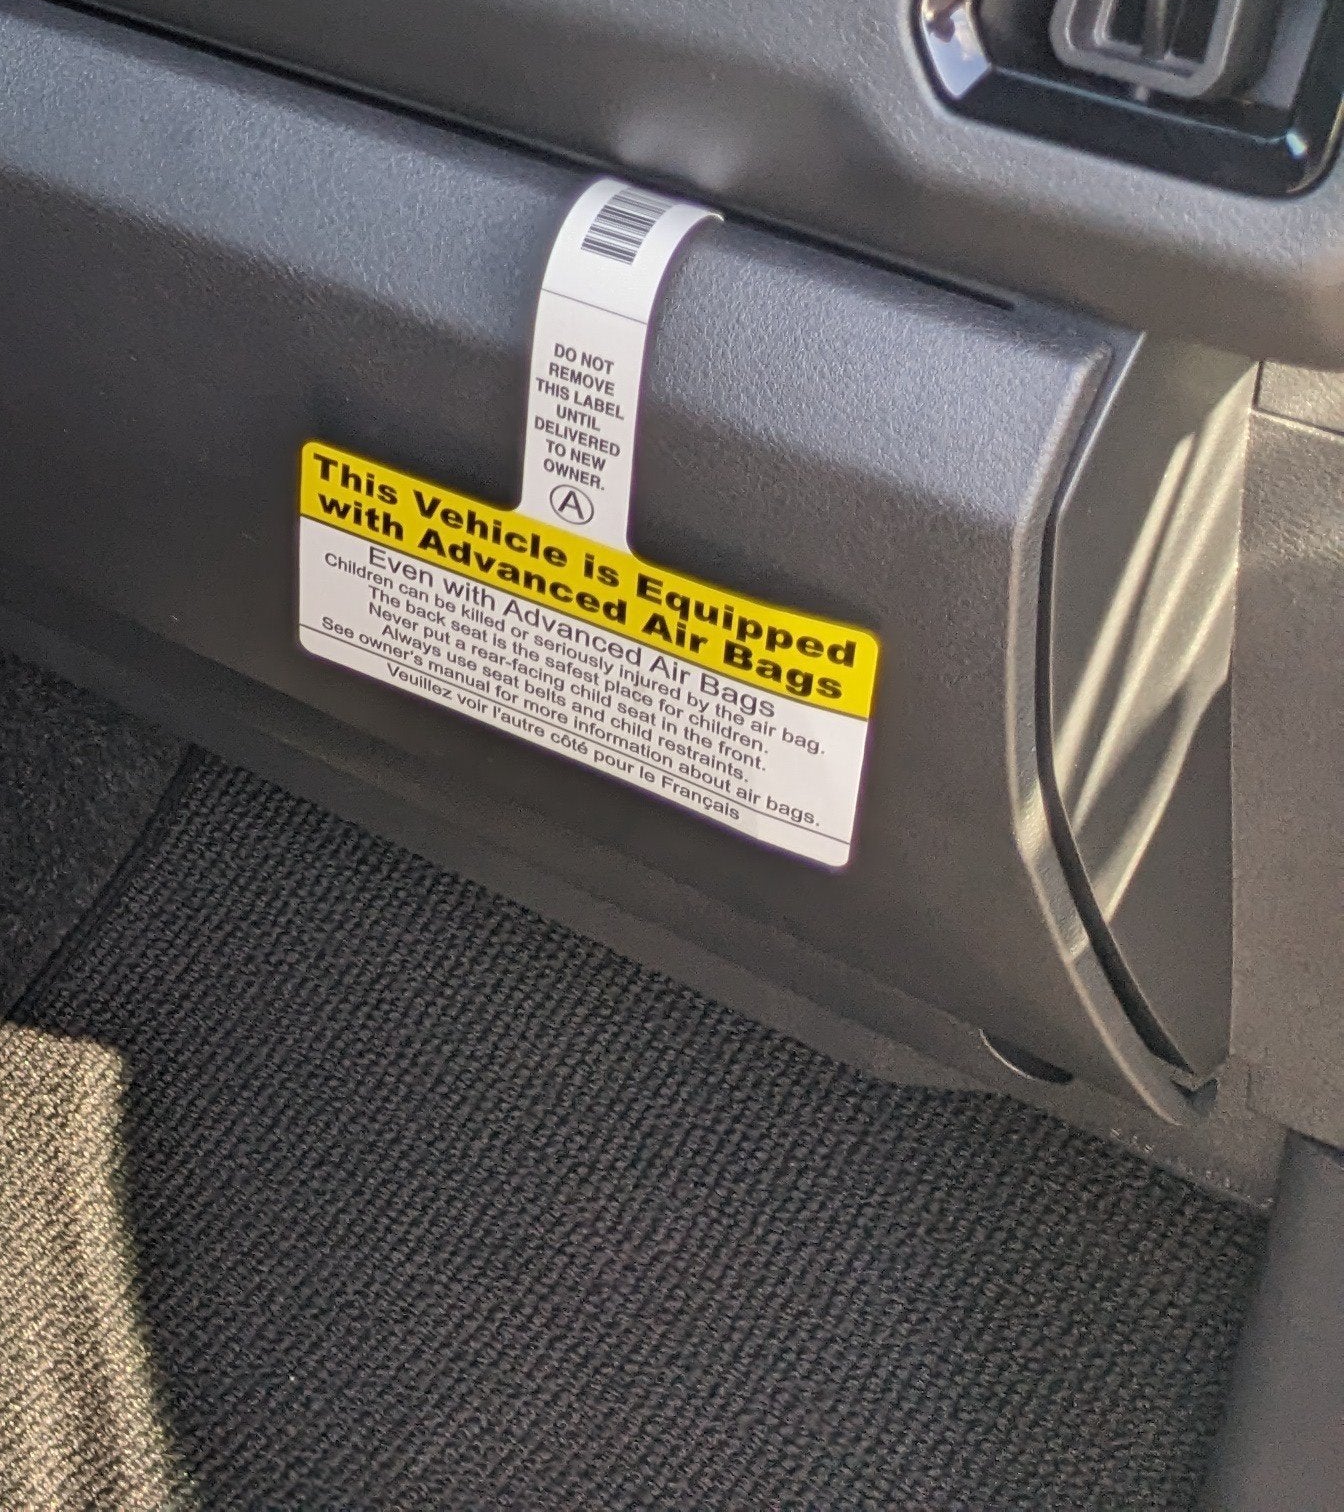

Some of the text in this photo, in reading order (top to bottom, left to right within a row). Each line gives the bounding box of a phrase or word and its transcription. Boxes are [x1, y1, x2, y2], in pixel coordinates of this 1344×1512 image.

[534, 415, 621, 458] DELIVERED
[535, 376, 625, 420] THIS LABEL
[548, 362, 615, 397] REMOVE
[554, 343, 615, 375] DO NOT
[556, 403, 601, 432] UNTIL
[543, 458, 605, 491] OWNER.
[545, 438, 607, 472] TO NEW
[557, 490, 585, 521] A
[313, 452, 858, 669] This Vehicle is Equipped
[317, 492, 844, 700] with Advanced Air Bags
[369, 545, 776, 719] Even with Advanced Air Bags
[321, 615, 820, 828] See owner's manual for more information about air bags.
[324, 551, 826, 756] Children can be killed or seriously injured by the air bag.
[368, 584, 770, 755] The back seat is the safest place for children.
[368, 601, 767, 773] Never put a rear-facing child seat in the front.
[381, 623, 750, 784] Always use seat belts and child restraints.
[386, 661, 741, 822] Veuillez voir l'autre côté pour le Français
